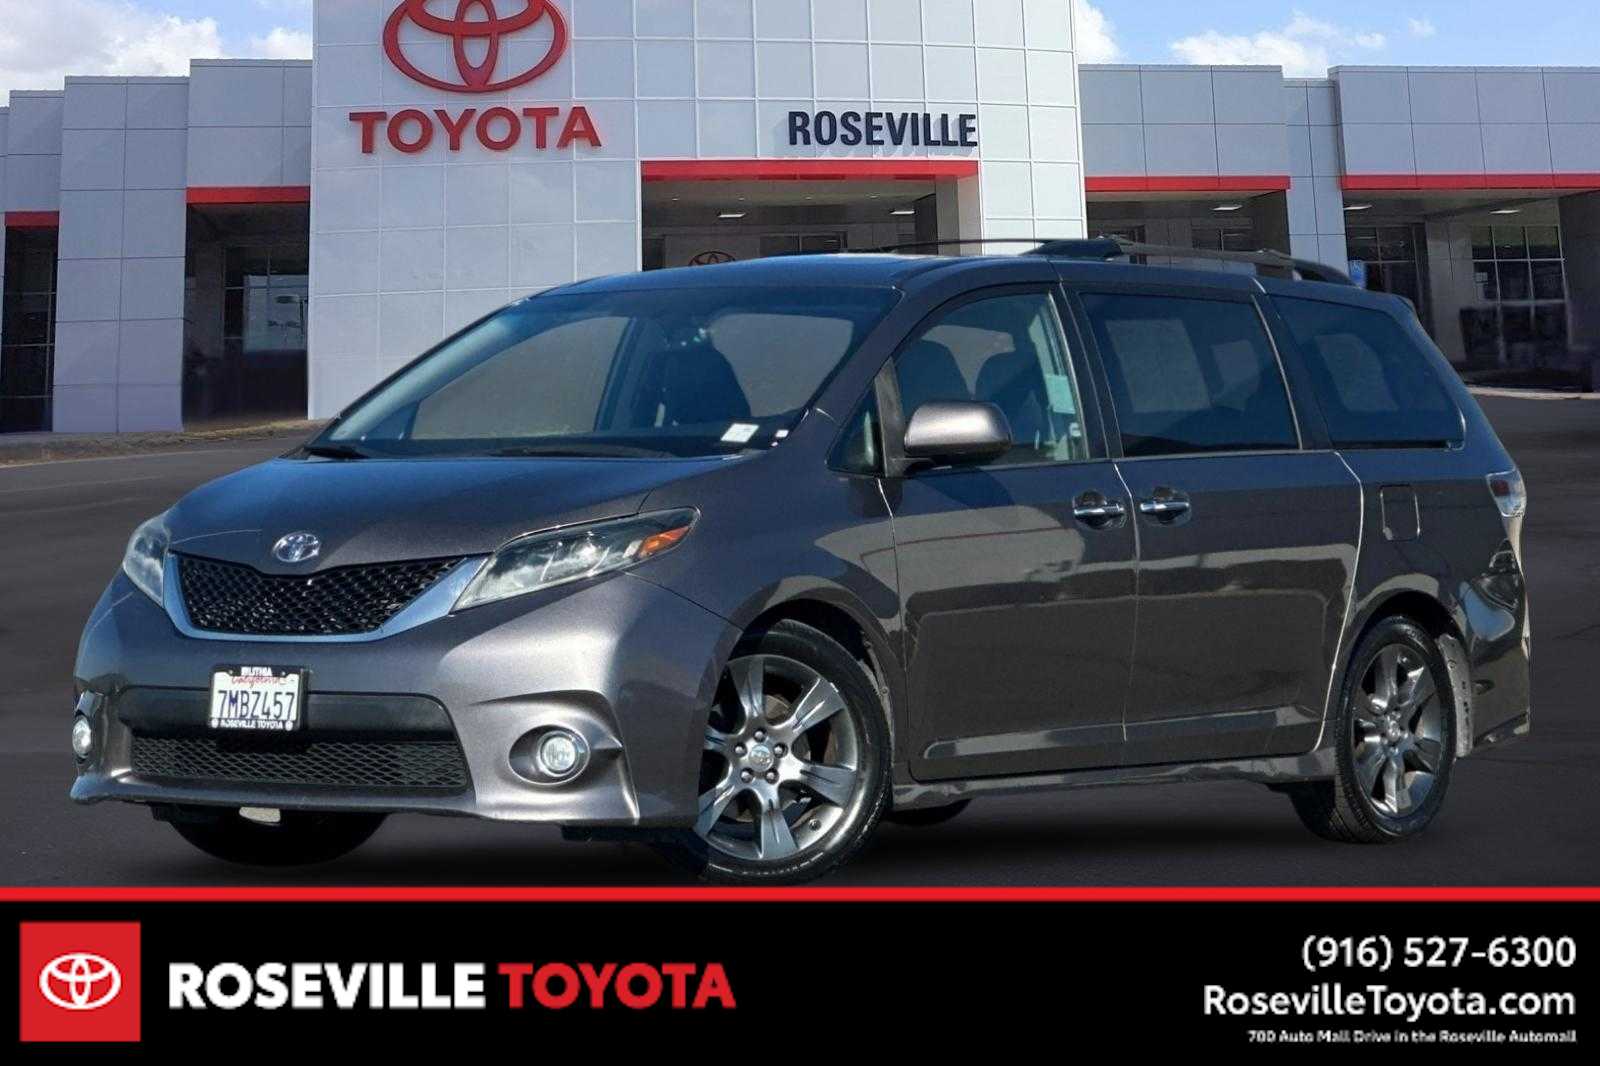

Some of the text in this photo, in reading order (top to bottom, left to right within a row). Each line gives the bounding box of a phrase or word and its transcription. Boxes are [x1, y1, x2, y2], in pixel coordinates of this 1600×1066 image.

[349, 106, 602, 154] TOYOTA
[788, 111, 978, 147] ROSEVILLE
[217, 690, 295, 720] 7MBZ457
[257, 720, 284, 730] TOYOTA
